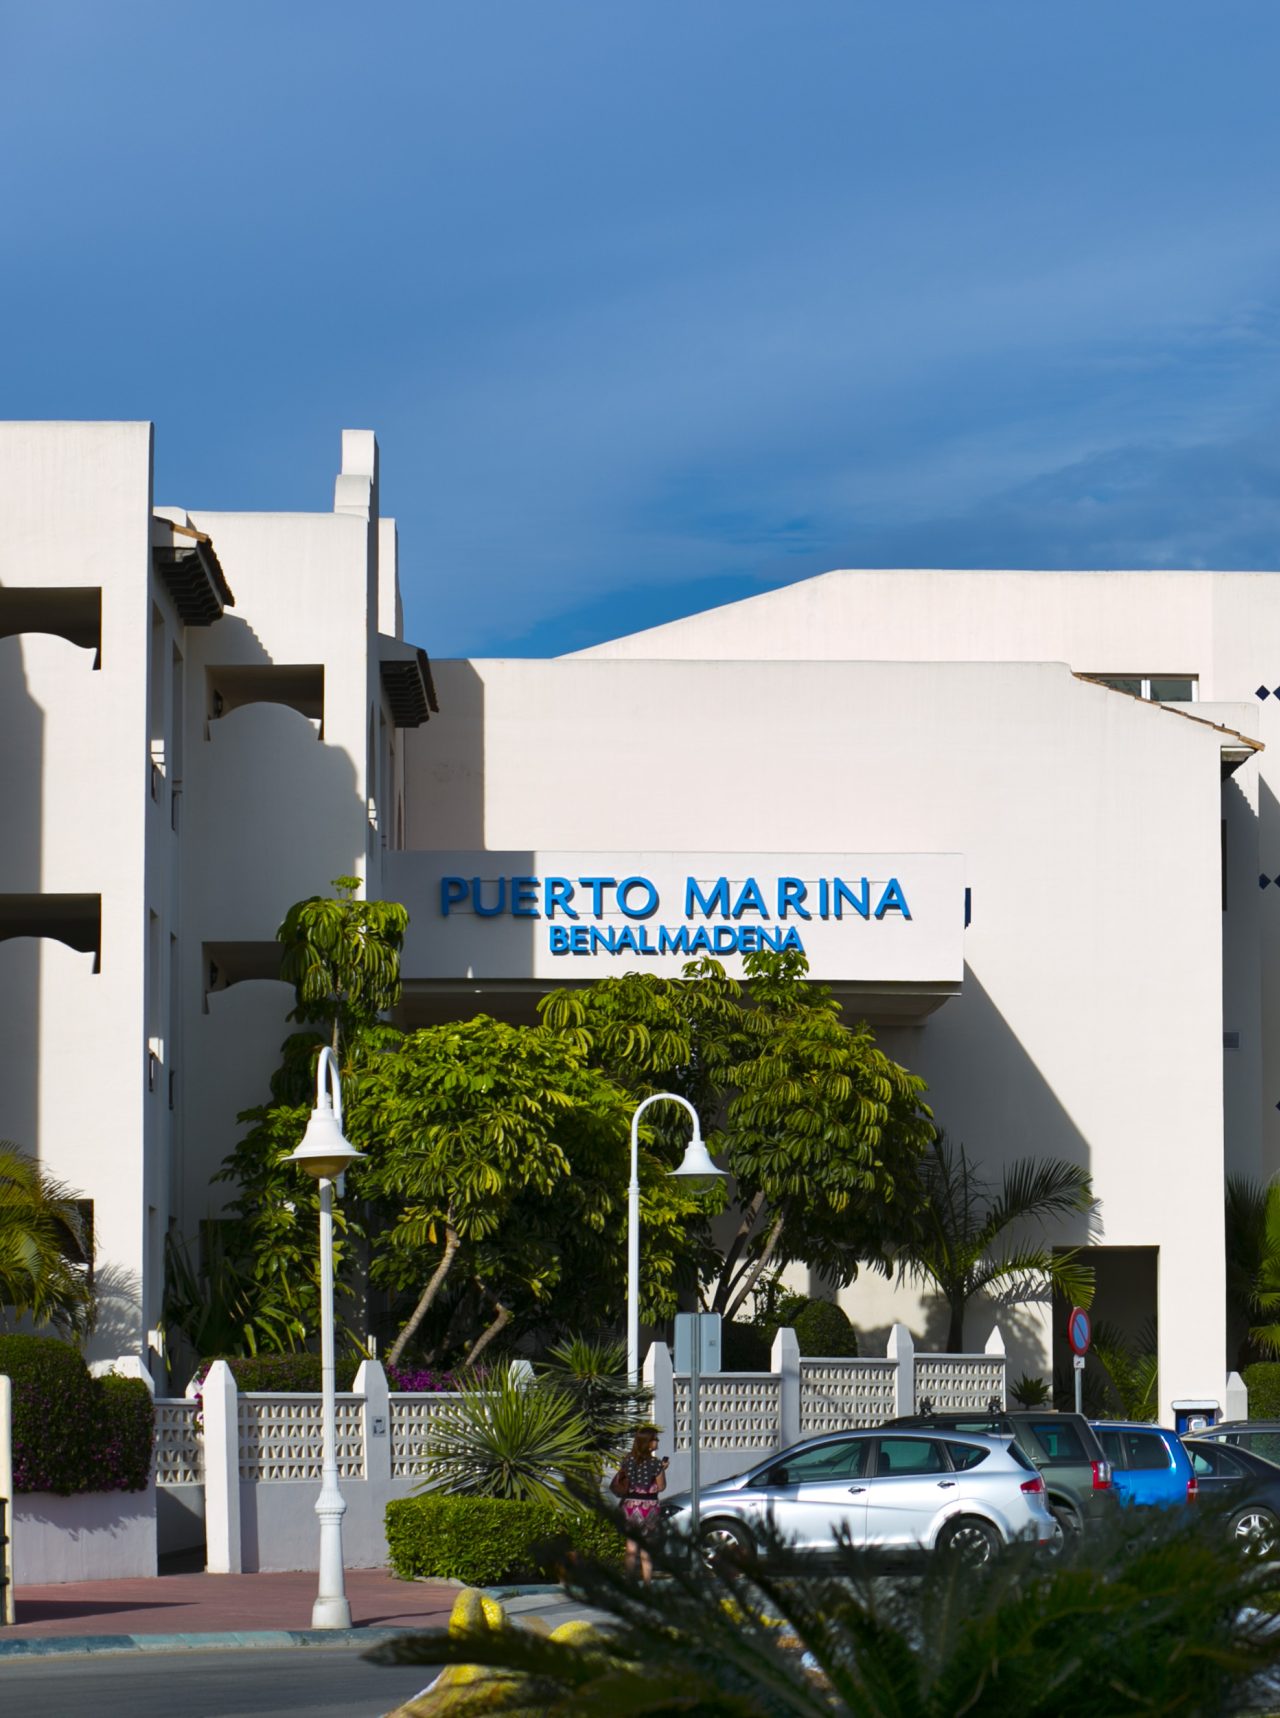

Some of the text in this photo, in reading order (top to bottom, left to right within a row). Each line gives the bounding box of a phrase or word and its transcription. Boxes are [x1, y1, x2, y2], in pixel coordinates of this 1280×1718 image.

[440, 876, 911, 919] PUERTO MARINA
[550, 925, 805, 955] BENALMADENA
